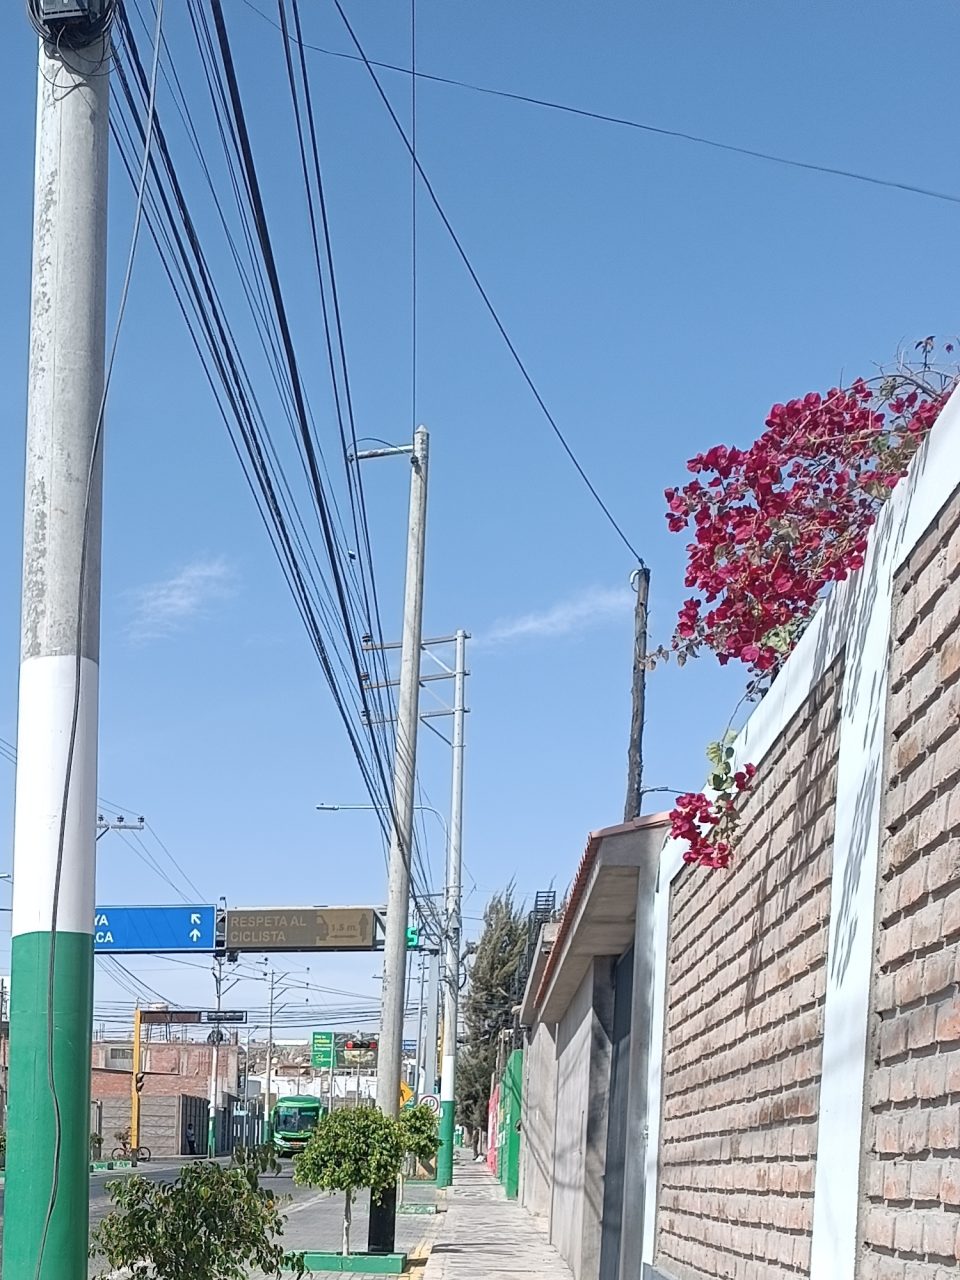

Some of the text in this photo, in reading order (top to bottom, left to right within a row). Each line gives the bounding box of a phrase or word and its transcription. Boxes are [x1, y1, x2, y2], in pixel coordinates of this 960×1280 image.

[231, 915, 306, 927] RESPETA AL
[331, 924, 345, 932] 1.5
[94, 932, 114, 943] CA
[230, 931, 287, 942] CICLISTA
